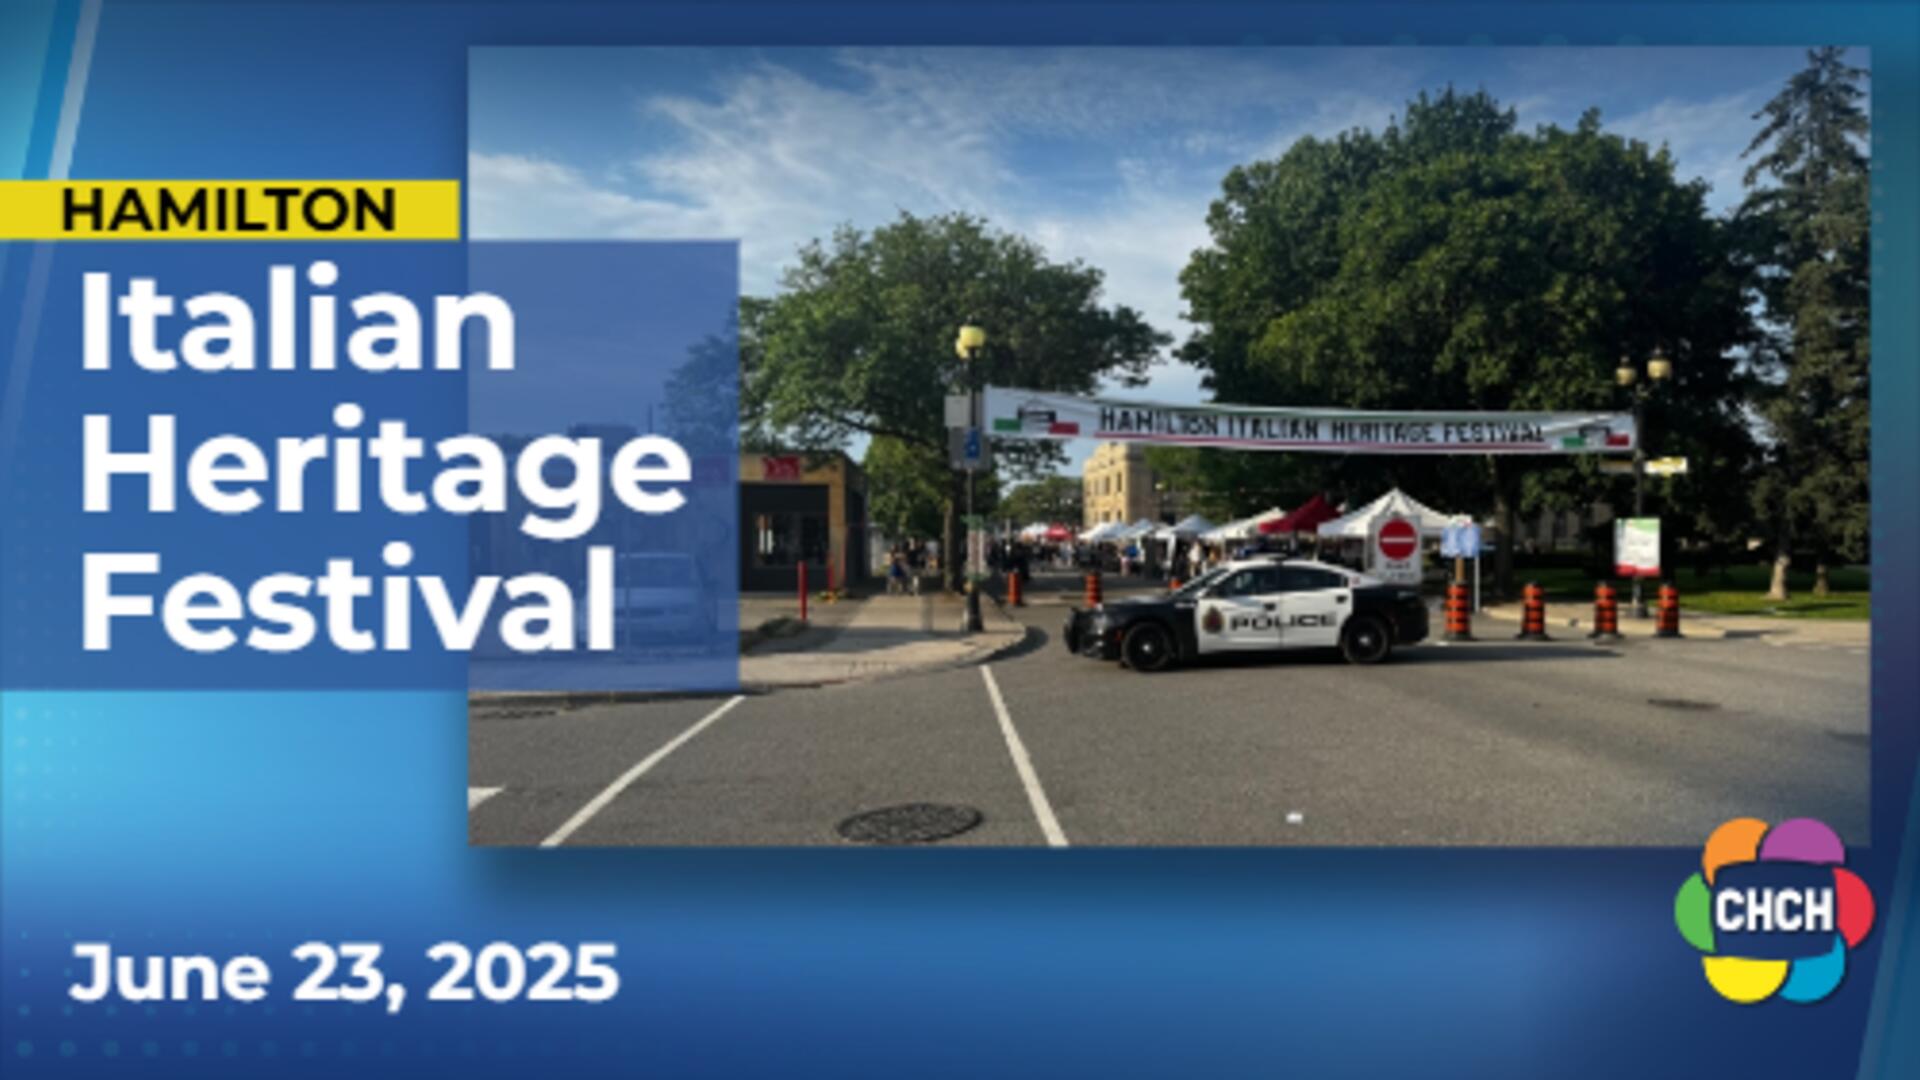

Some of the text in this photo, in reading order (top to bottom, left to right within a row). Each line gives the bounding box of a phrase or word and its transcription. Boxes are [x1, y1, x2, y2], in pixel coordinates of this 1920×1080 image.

[1100, 406, 1546, 443] HAMILTON ITALIAN HERITAGE FESTIVAL
[1229, 612, 1337, 631] POLICE
